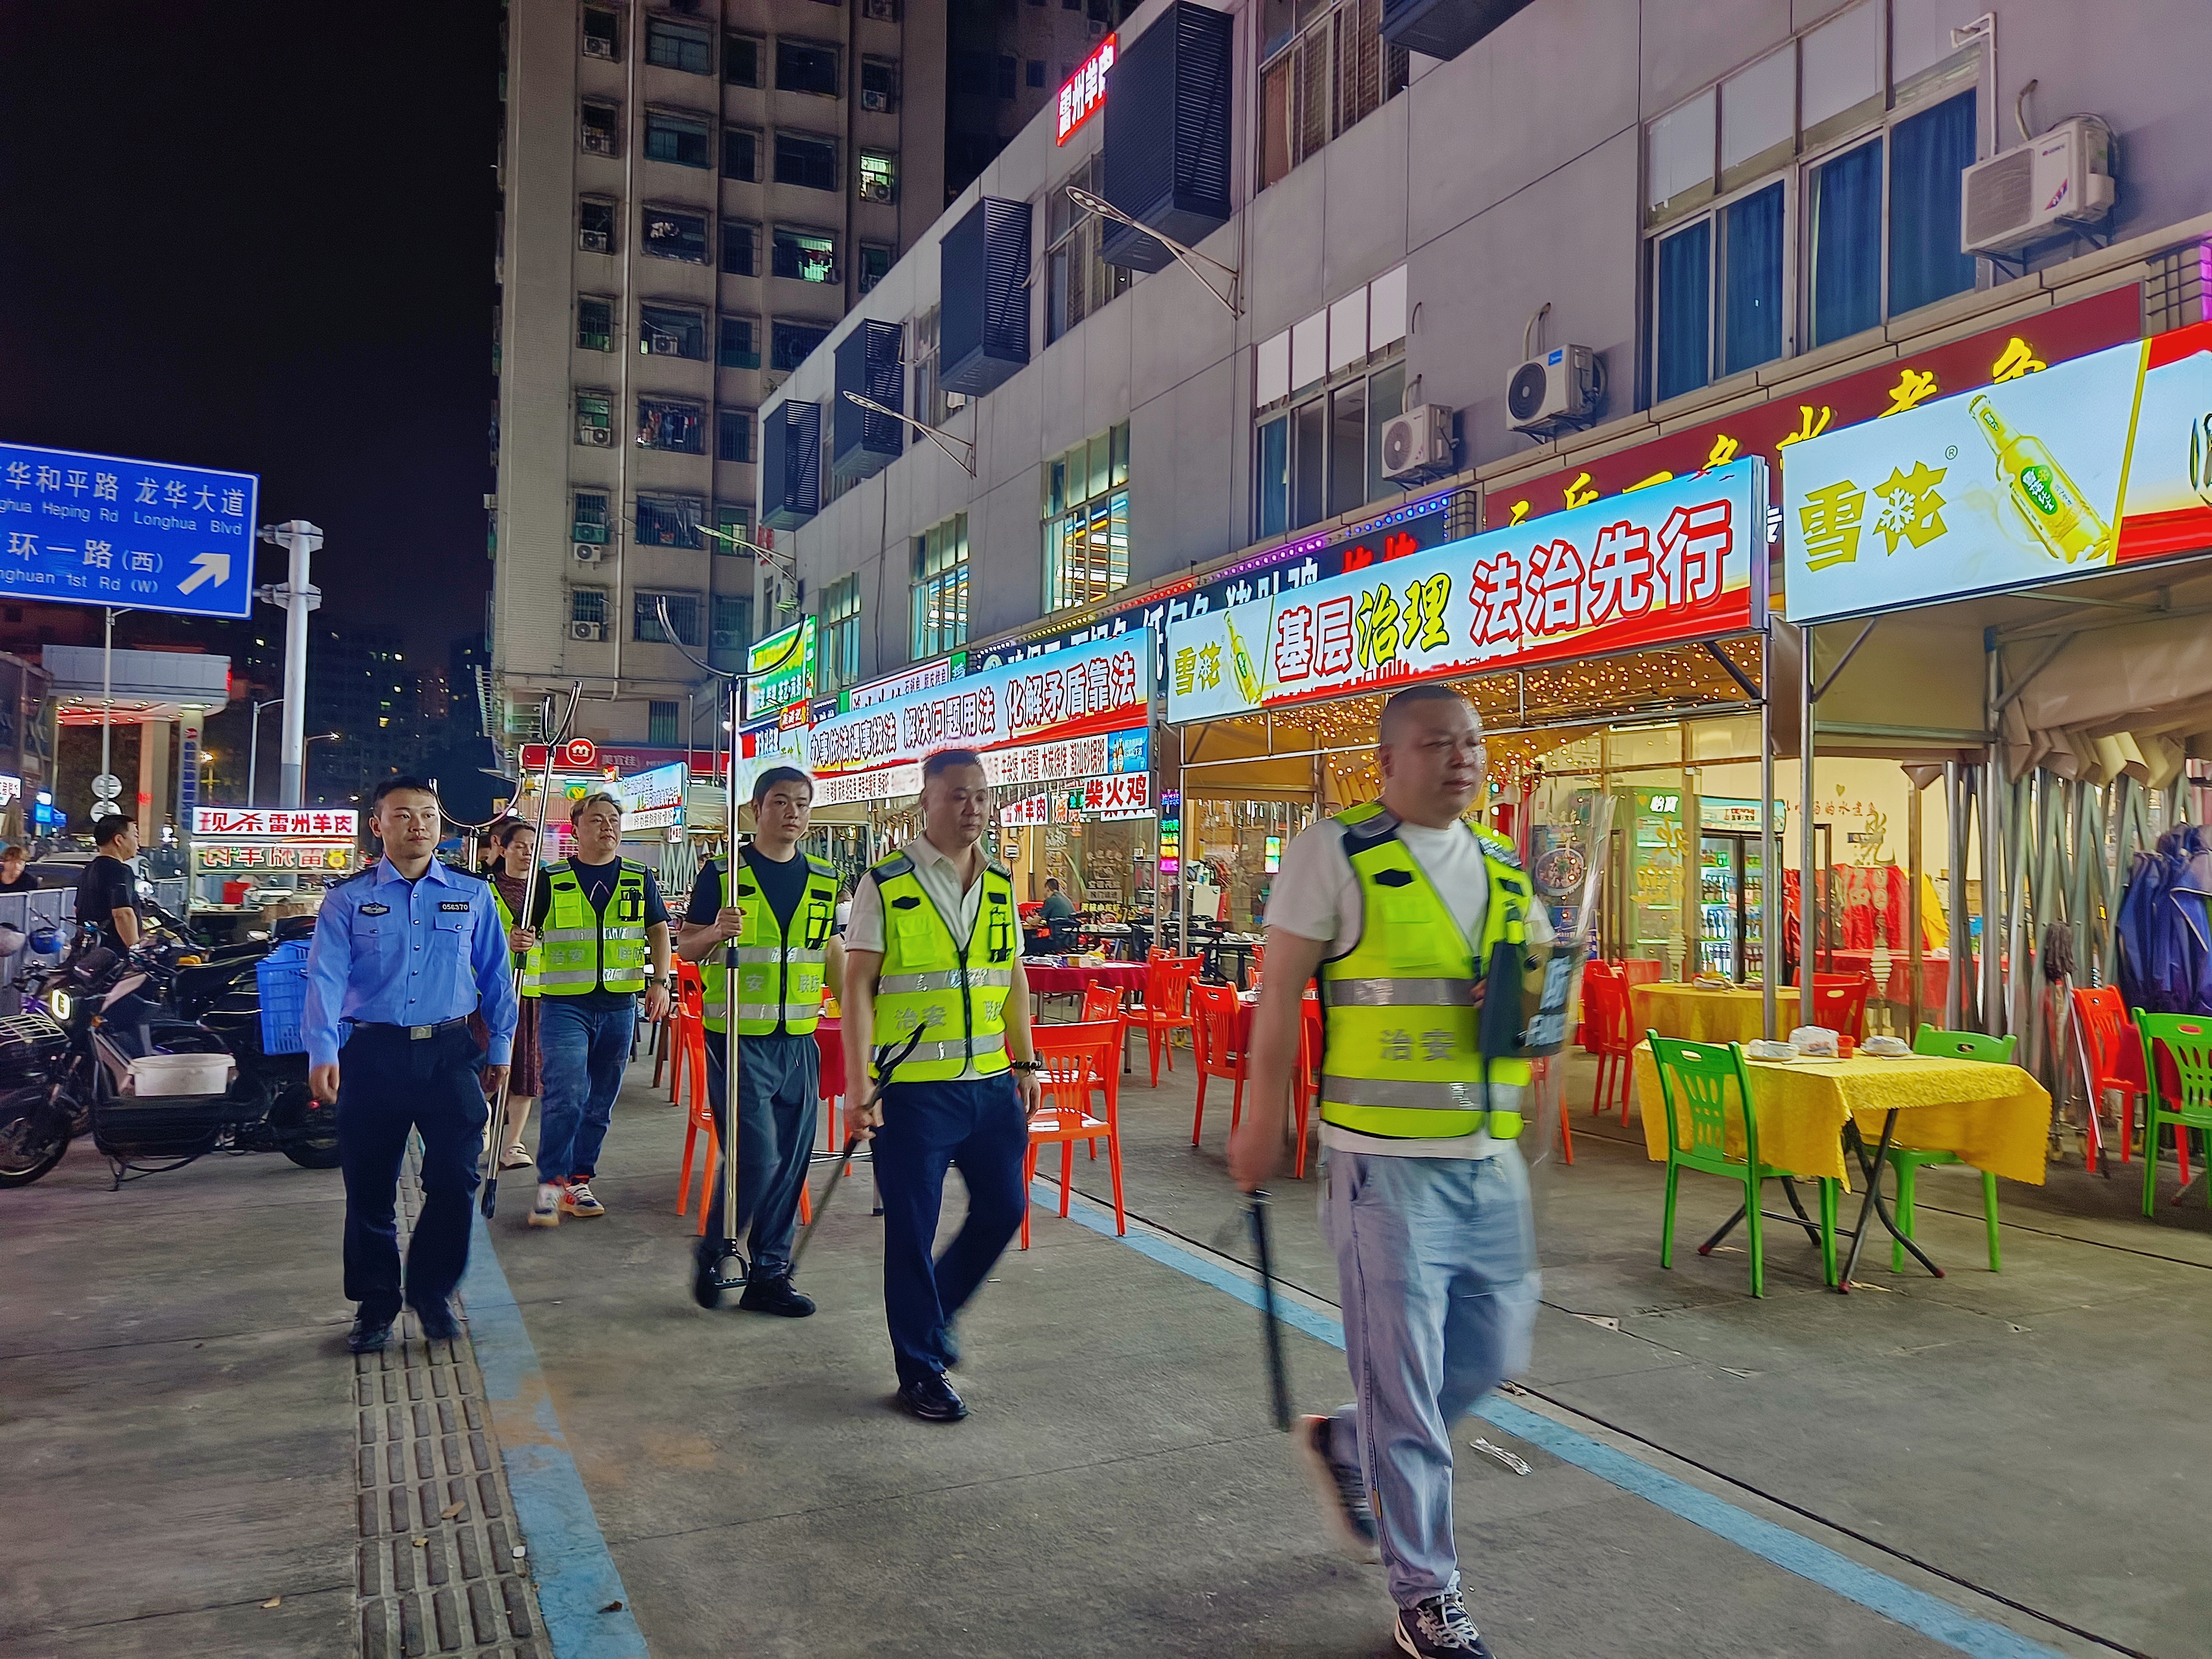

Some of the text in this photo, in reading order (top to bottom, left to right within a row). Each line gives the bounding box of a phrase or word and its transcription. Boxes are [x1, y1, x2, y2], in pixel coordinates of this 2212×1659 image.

[0, 461, 245, 517] 华和平路 龙华大道
[42, 501, 91, 522] Heping
[99, 507, 119, 523] Rd
[133, 511, 197, 530] Longhua
[210, 520, 242, 535] Blvd
[1799, 461, 1947, 572] 雪花
[66, 572, 88, 588] 1st
[99, 576, 121, 591] Rd
[131, 579, 159, 593] (W)
[1275, 572, 1452, 683] 基层治理
[1468, 499, 1732, 648] 法治先行
[1175, 640, 1222, 697] 雪花
[810, 712, 897, 769] 办事依法遇事找法
[903, 686, 995, 749] 解决问题用法
[1005, 651, 1136, 729] 化解矛盾靠法
[1085, 774, 1147, 809] 柴火鸡
[894, 1005, 947, 1030] 治安
[1379, 1028, 1456, 1062] 治安
